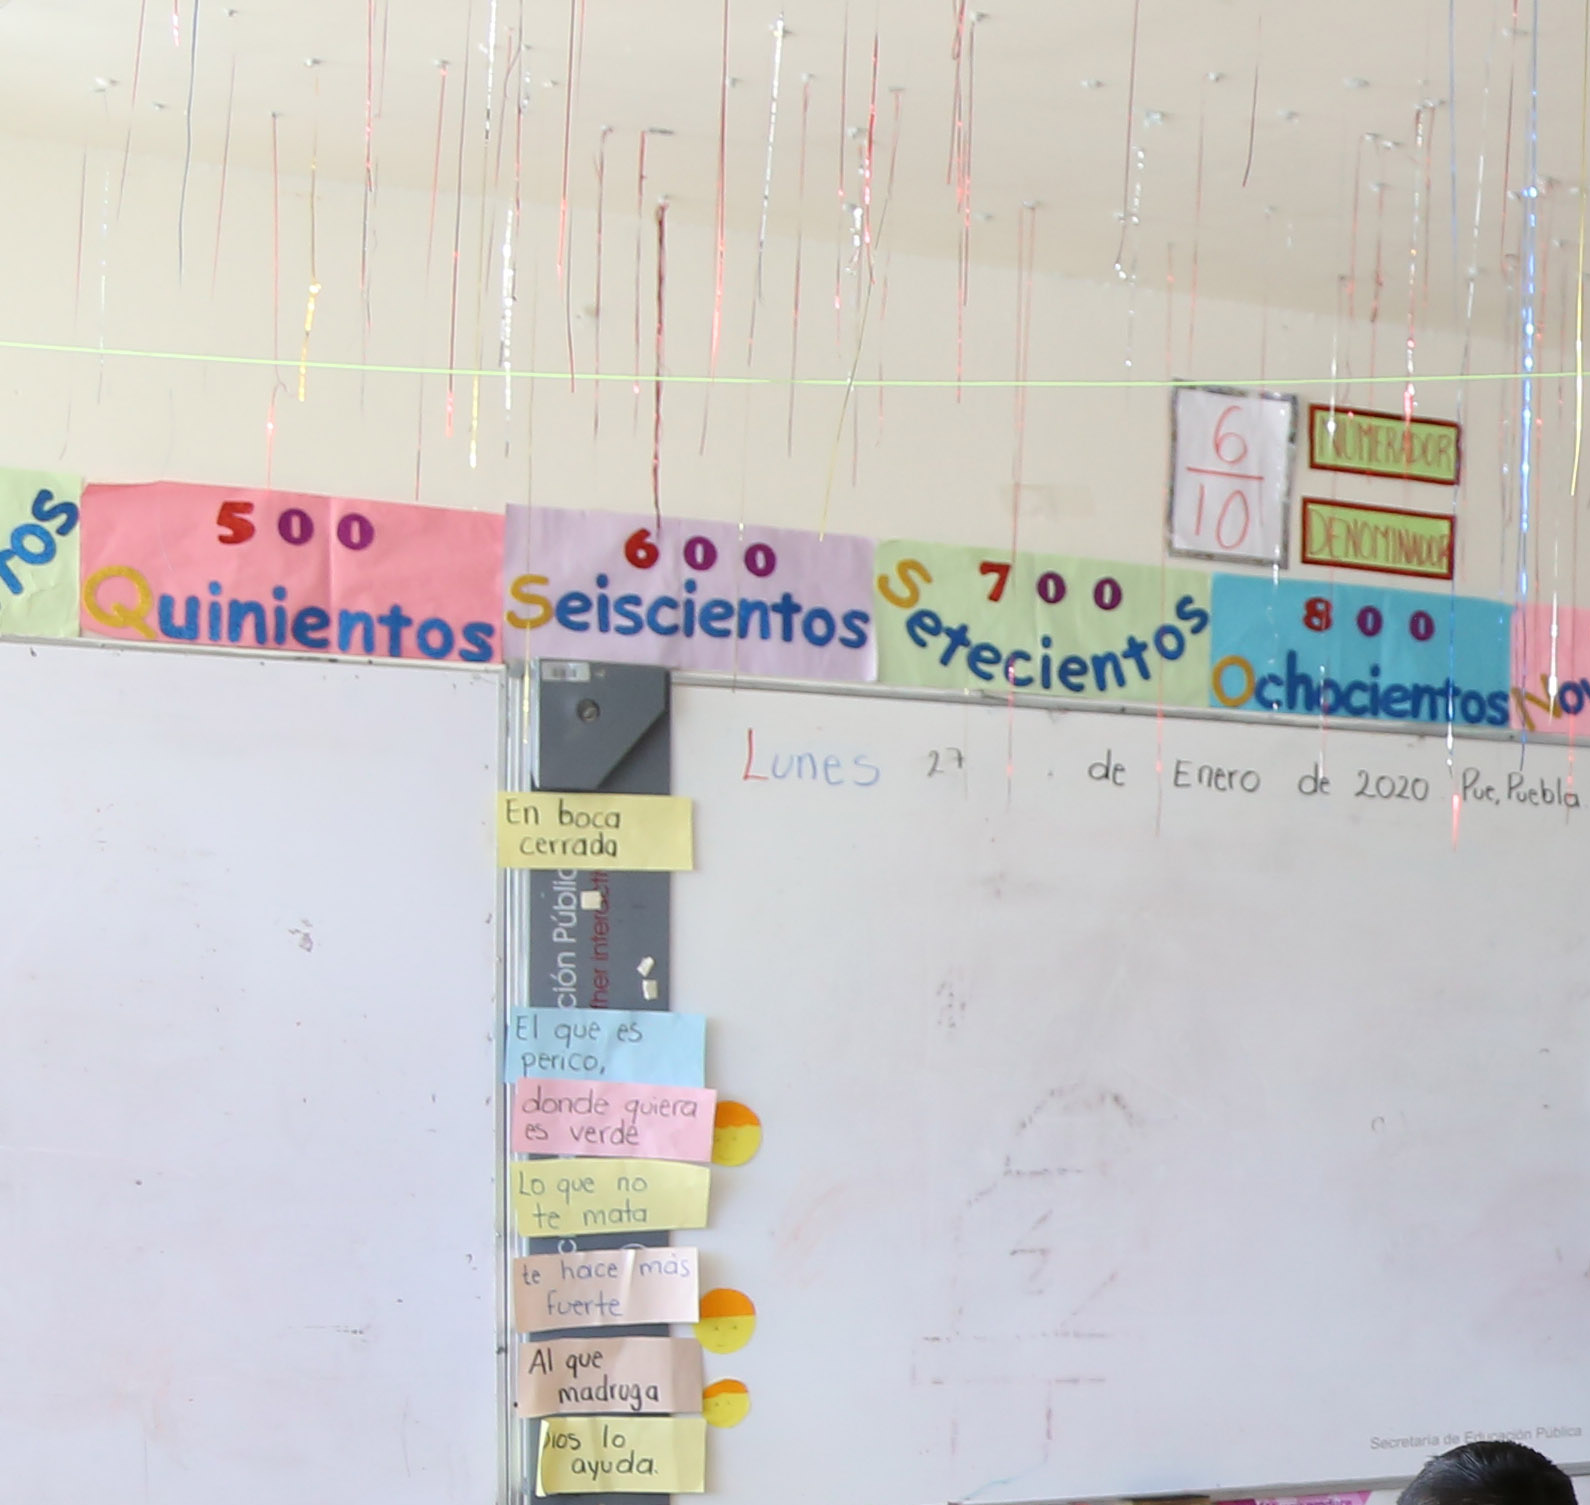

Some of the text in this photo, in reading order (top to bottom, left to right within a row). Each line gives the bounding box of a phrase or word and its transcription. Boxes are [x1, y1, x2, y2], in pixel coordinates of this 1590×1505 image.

[1212, 404, 1250, 466] 6
[1317, 413, 1453, 470] NUMERADOR
[81, 564, 495, 664] Quinientos
[506, 573, 872, 651] Seiscientos
[876, 557, 1211, 693] Setecientos
[1211, 649, 1510, 729] Ochocientos
[743, 728, 881, 787] Lunes
[925, 747, 965, 779] 27
[1088, 747, 1126, 784] de
[1173, 757, 1262, 795] Enero
[1297, 761, 1331, 798] de
[1354, 771, 1430, 803] 2020
[505, 797, 622, 830] En boca
[518, 831, 619, 858] cerrada
[515, 1013, 644, 1050] El que es
[520, 1084, 697, 1126] donde quiera
[524, 1119, 642, 1147] es verde
[517, 1170, 649, 1203] Lo que no
[531, 1198, 649, 1230] te mata
[522, 1252, 691, 1287] te hace más
[545, 1287, 625, 1318] fuerte
[527, 1345, 604, 1379] Al que
[557, 1373, 661, 1412] madruga
[601, 1423, 628, 1450] lo
[1443, 1430, 1461, 1446] de
